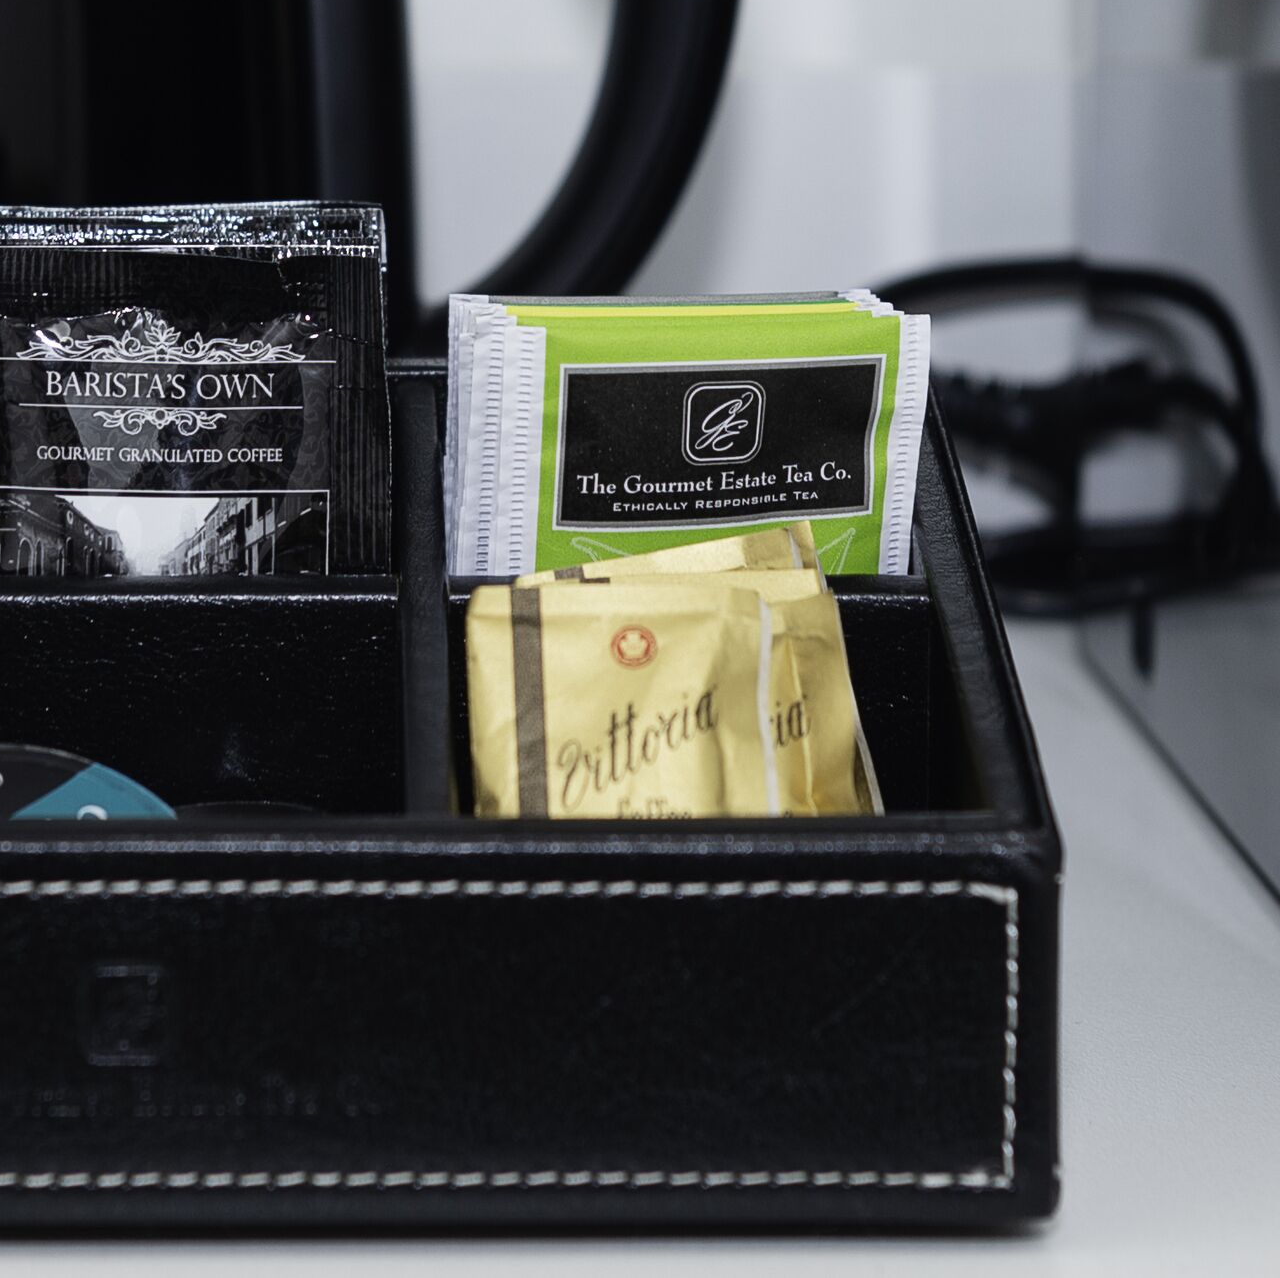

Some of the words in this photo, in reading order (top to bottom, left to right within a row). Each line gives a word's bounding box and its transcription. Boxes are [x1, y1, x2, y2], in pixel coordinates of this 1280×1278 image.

[45, 370, 185, 400] BARISTA'S
[196, 372, 276, 401] OWN
[36, 444, 115, 463] GOURMET
[119, 446, 223, 464] GRANULATED
[227, 447, 284, 464] COFFEE
[577, 472, 617, 496] The
[623, 474, 713, 495] Gourmet
[720, 470, 777, 491] Estate
[782, 464, 813, 485] Tea
[820, 461, 852, 482] Co.
[613, 501, 689, 513] ETHICALLY
[695, 492, 787, 510] RESPONSIBLE
[793, 490, 820, 501] TEA
[557, 684, 720, 812] Vittoria
